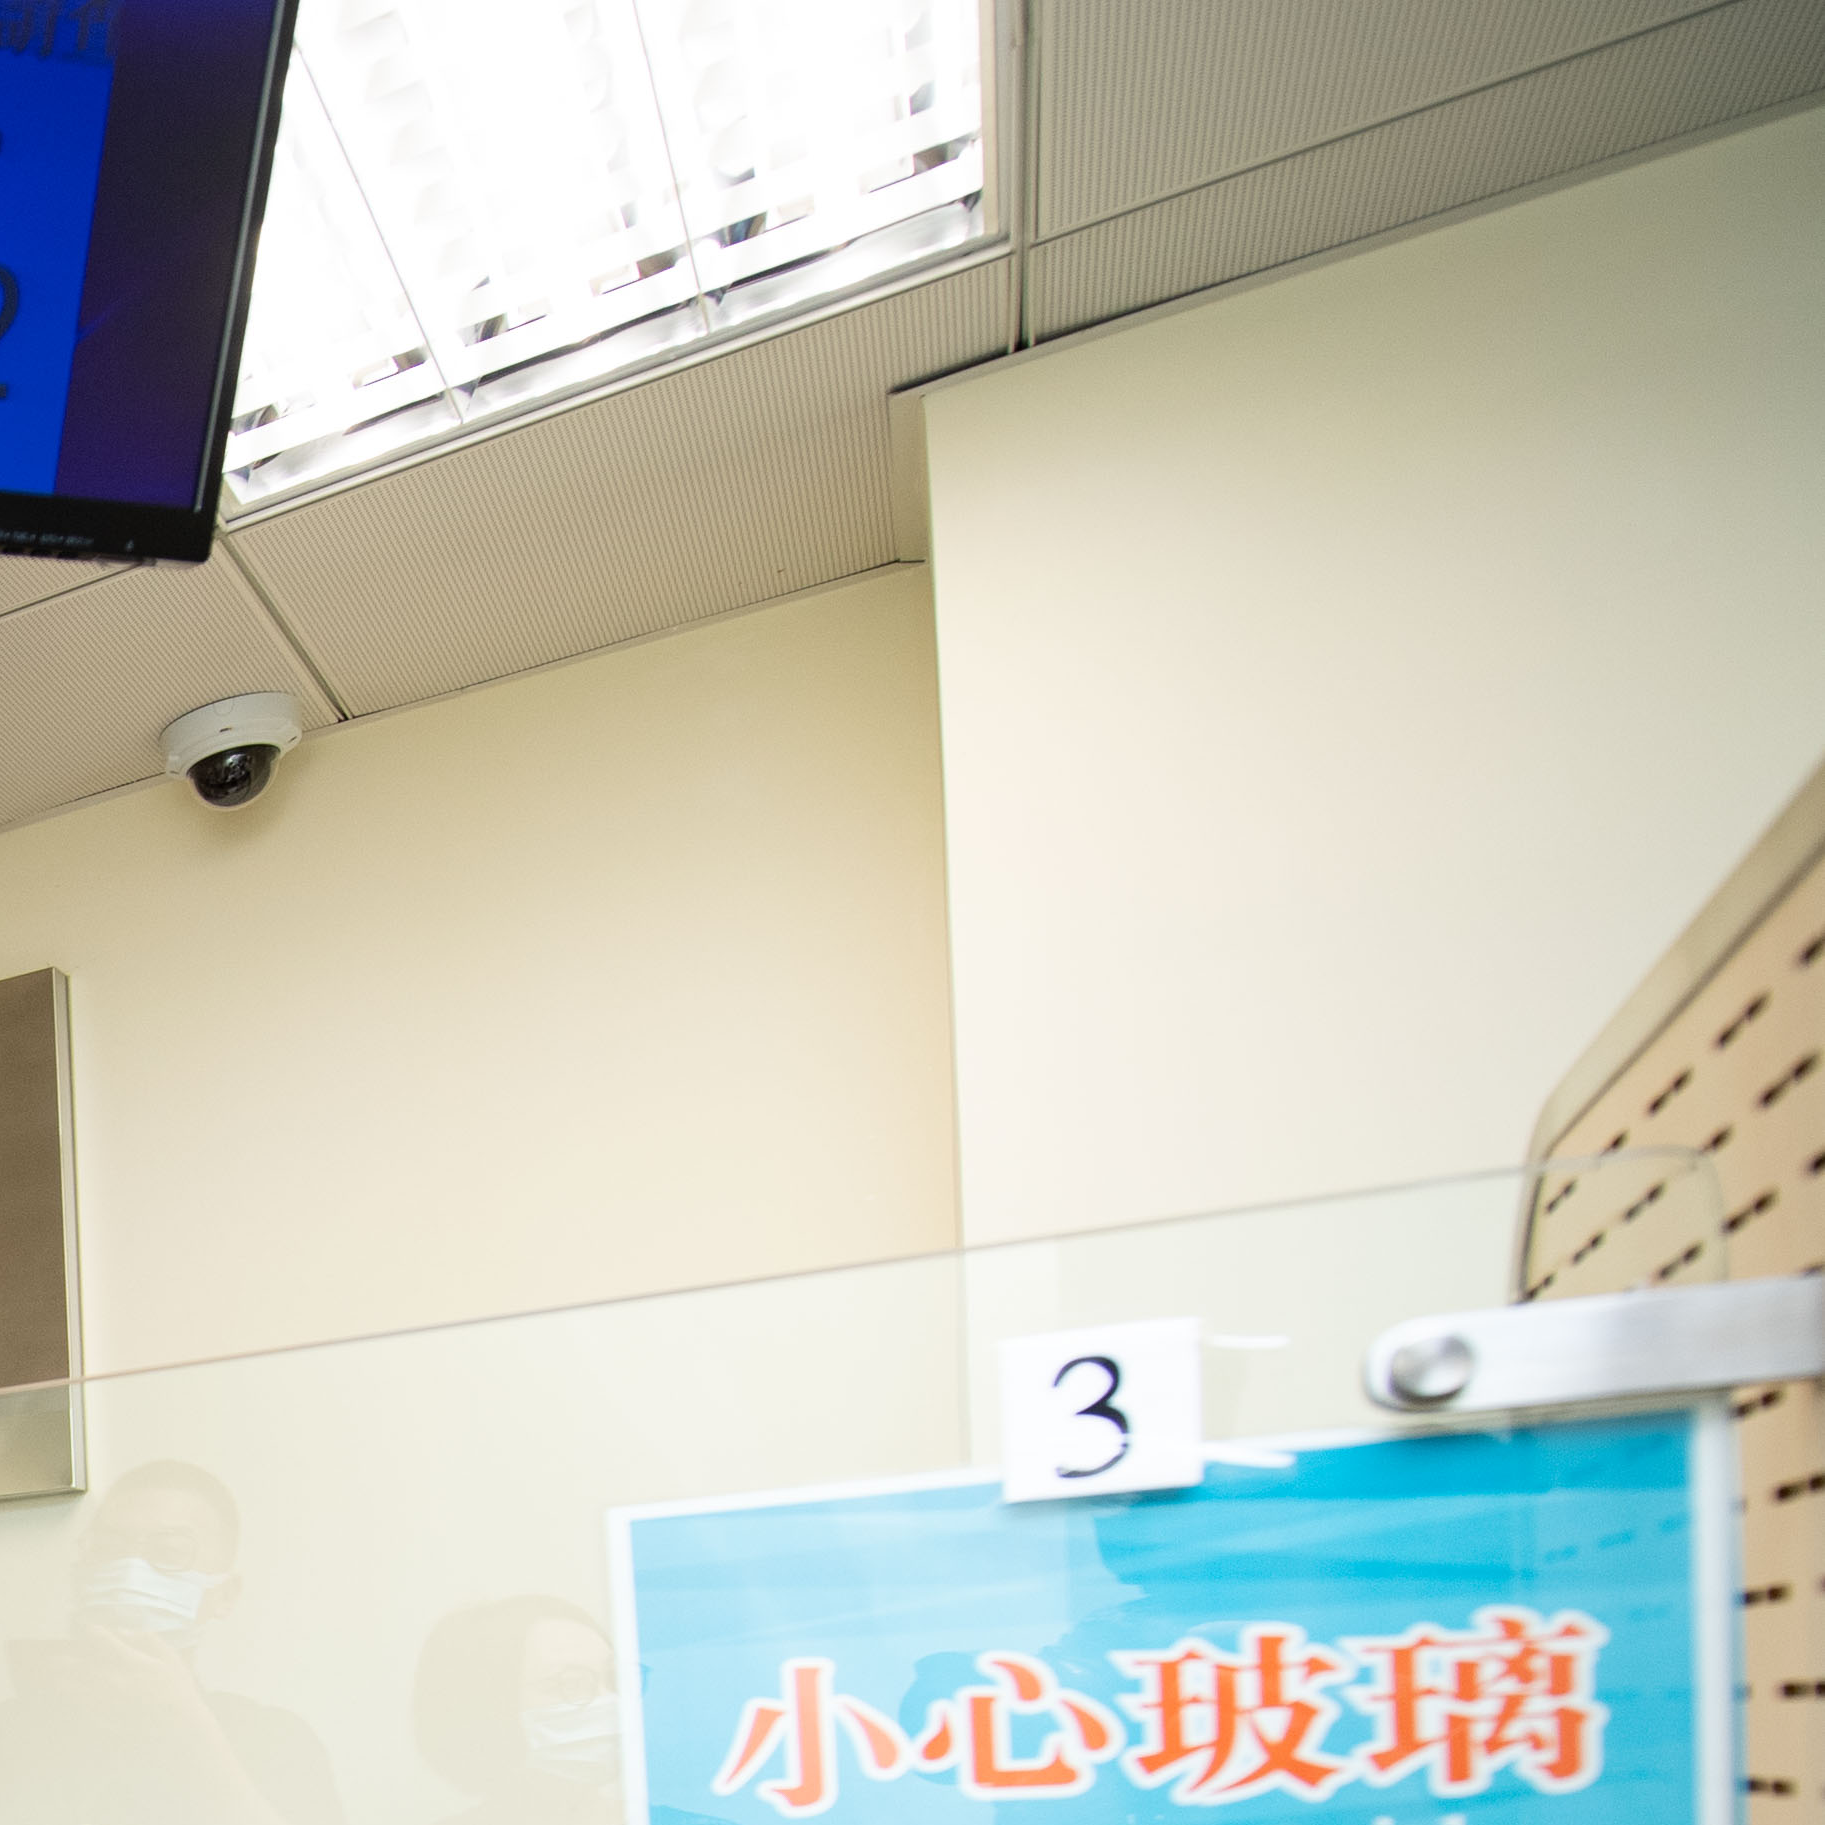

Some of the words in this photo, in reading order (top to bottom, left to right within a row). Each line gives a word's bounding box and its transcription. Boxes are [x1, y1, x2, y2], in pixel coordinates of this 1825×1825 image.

[1051, 1354, 1131, 1479] 3
[718, 1610, 1604, 1812] 小心玻璃
